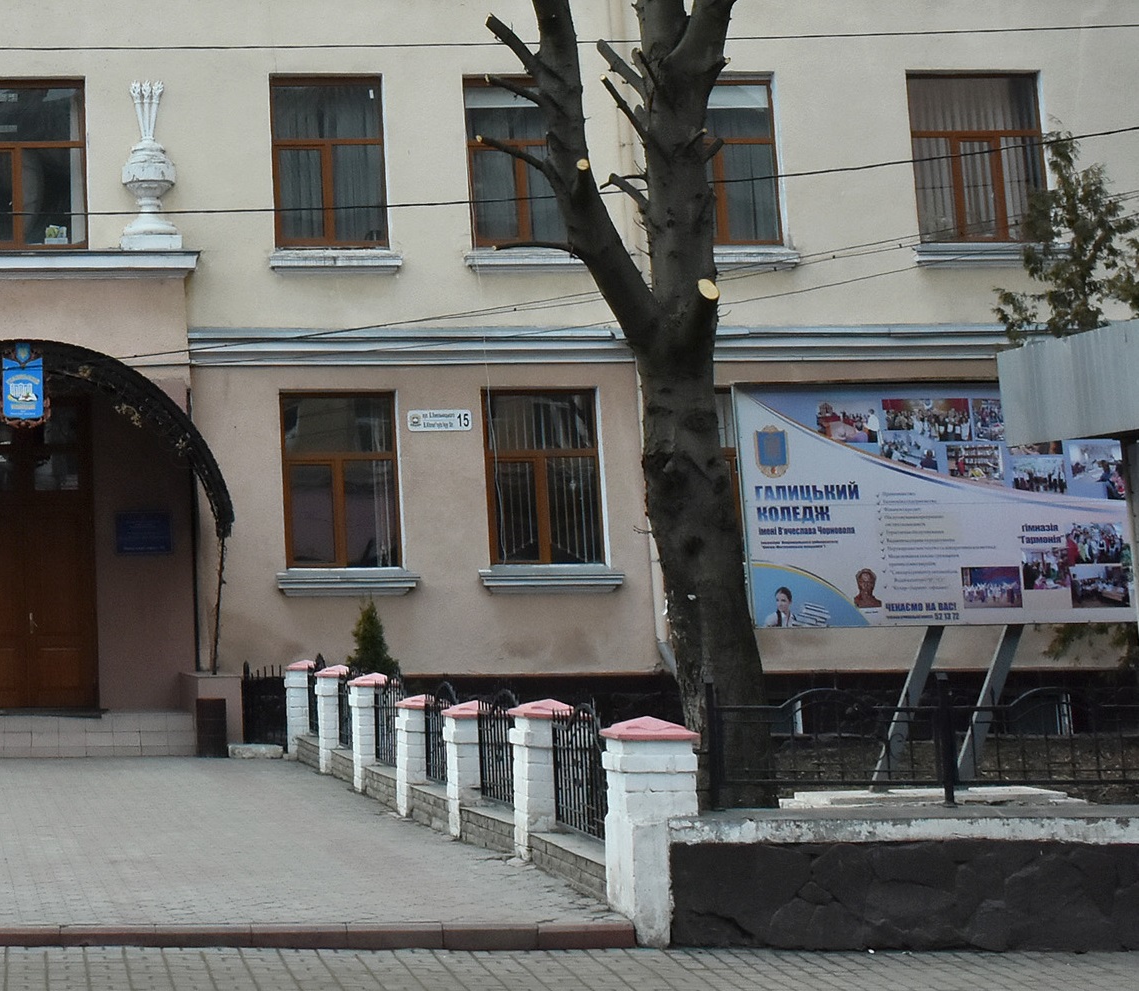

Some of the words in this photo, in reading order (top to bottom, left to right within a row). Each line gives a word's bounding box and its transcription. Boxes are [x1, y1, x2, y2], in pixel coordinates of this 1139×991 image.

[457, 413, 469, 427] 15
[755, 481, 860, 502] ГАЛИЦЬКИЙ
[757, 506, 830, 523] КОЛЕДЖ
[1022, 523, 1059, 532] гімназія
[885, 603, 923, 612] ЧЕКАЄМО
[925, 603, 936, 611] НА
[938, 603, 957, 611] ВАС!
